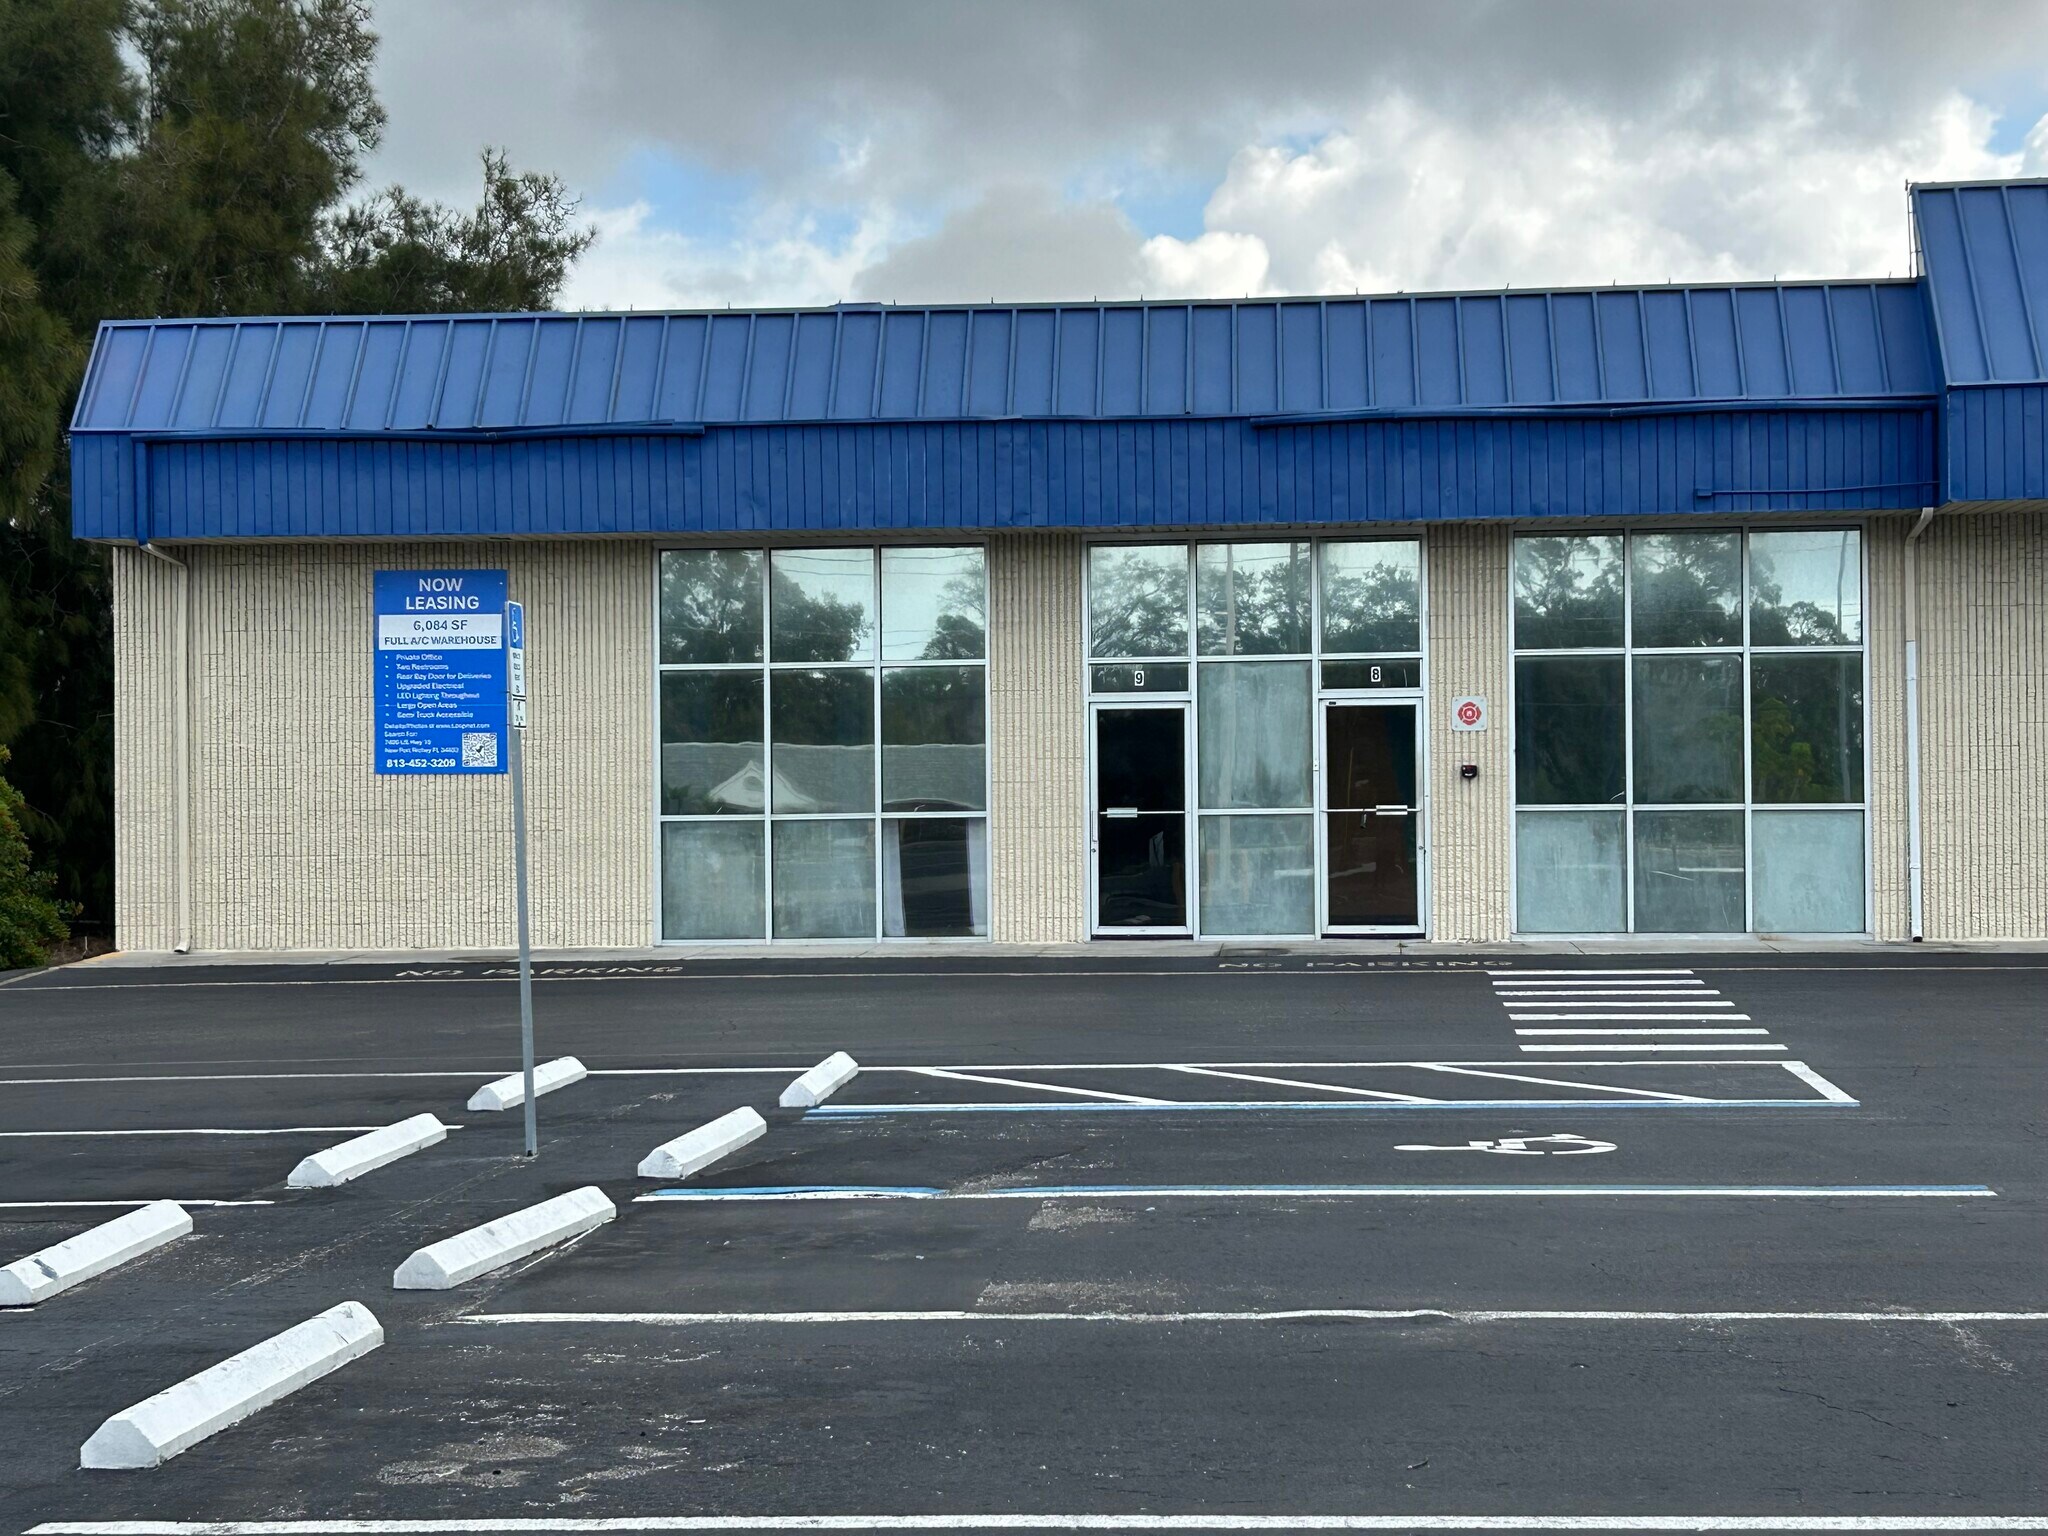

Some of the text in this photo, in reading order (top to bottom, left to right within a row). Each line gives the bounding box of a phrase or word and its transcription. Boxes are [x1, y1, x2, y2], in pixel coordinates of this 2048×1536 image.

[419, 578, 463, 592] NOW
[406, 596, 479, 610] LEASING
[413, 620, 468, 632] 6,084 SF
[384, 636, 497, 645] FULL A/C WAREHOUSE
[414, 673, 427, 681] Bay
[1135, 673, 1144, 685] 9
[1372, 668, 1380, 681] 8
[412, 692, 440, 700] Lighting
[441, 692, 480, 700] Throughout
[397, 702, 416, 710] Large
[386, 758, 456, 768] 813-452-3209
[394, 969, 464, 977] NO
